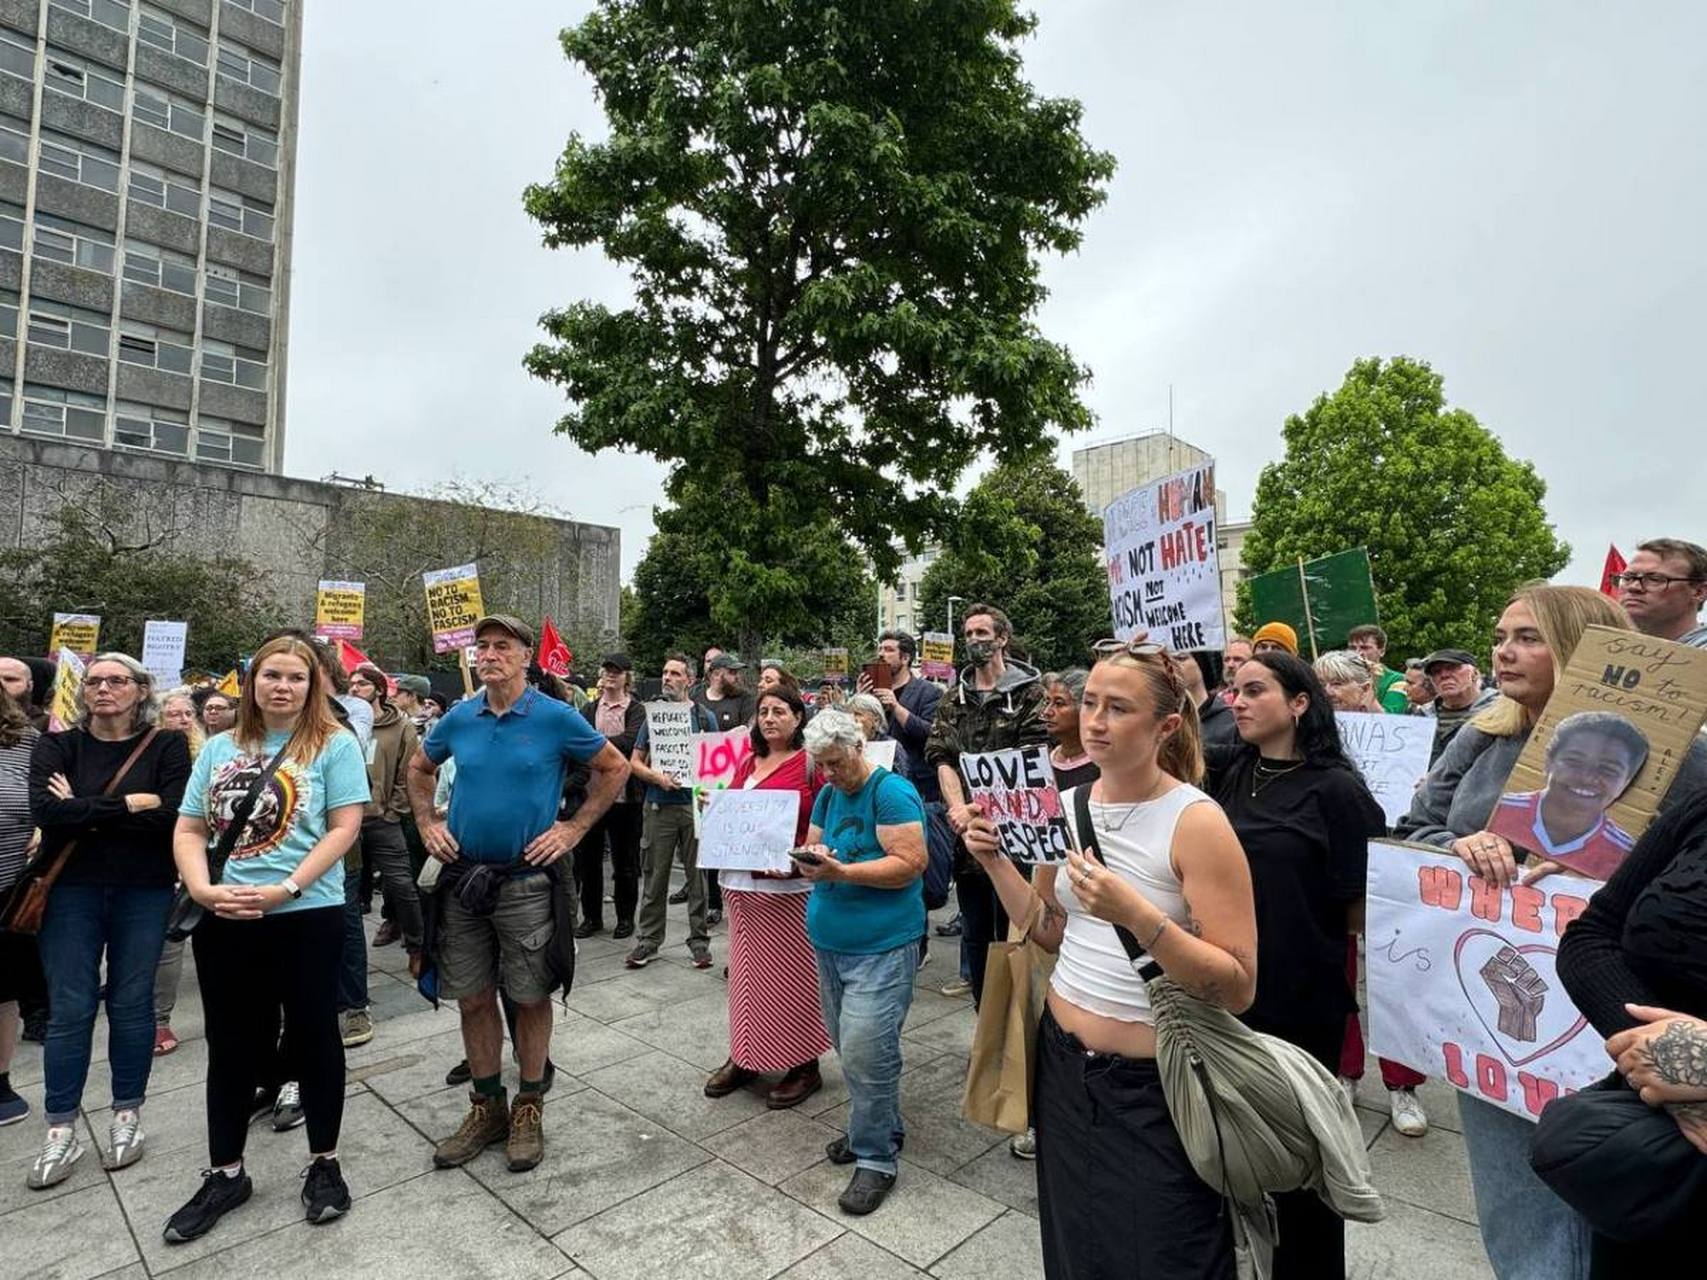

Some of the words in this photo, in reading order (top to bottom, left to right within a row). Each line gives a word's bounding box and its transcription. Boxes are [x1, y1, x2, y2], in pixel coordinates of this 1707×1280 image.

[1128, 541, 1154, 578] NOT
[1160, 521, 1214, 571] HATE!
[428, 586, 443, 598] NO
[444, 584, 458, 595] TO
[430, 593, 469, 608] RACISM
[1145, 580, 1164, 597] NOT
[432, 608, 447, 620] NO
[449, 605, 463, 616] TO
[433, 613, 477, 631] FASCISM
[1145, 602, 1186, 628] WELCOME
[1171, 622, 1206, 651] HERE
[1601, 664, 1641, 690] NO
[698, 736, 751, 778] LOV
[962, 749, 1046, 790] LOVE
[986, 789, 1041, 820] AND
[998, 817, 1072, 861] ESPECT
[1375, 927, 1431, 972] is
[1442, 1041, 1578, 1117] LOV
